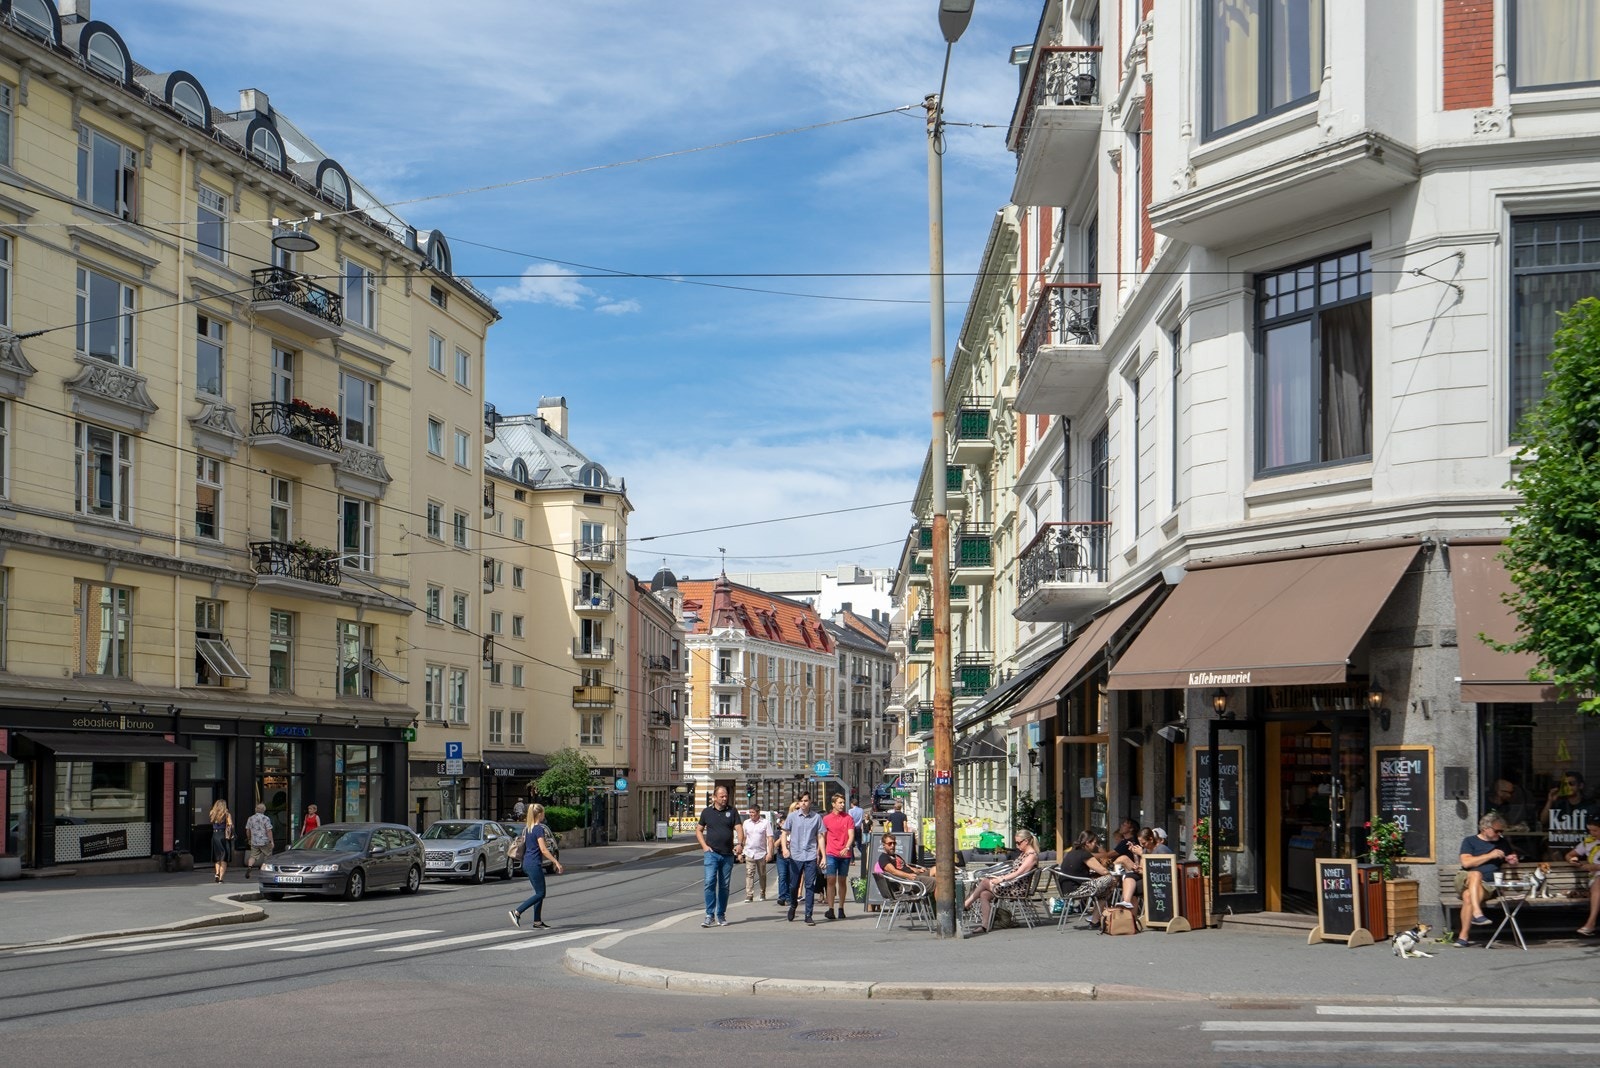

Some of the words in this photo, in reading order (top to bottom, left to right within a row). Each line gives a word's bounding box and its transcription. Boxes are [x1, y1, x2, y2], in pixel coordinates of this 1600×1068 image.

[1188, 671, 1251, 685] Kaffebrenneriet
[72, 716, 119, 727] sebastien
[126, 719, 154, 729] bruno
[449, 743, 459, 757] P
[1380, 760, 1422, 774] ISKREM!
[1548, 808, 1588, 830] Kaff
[1323, 877, 1351, 890] ISKREM
